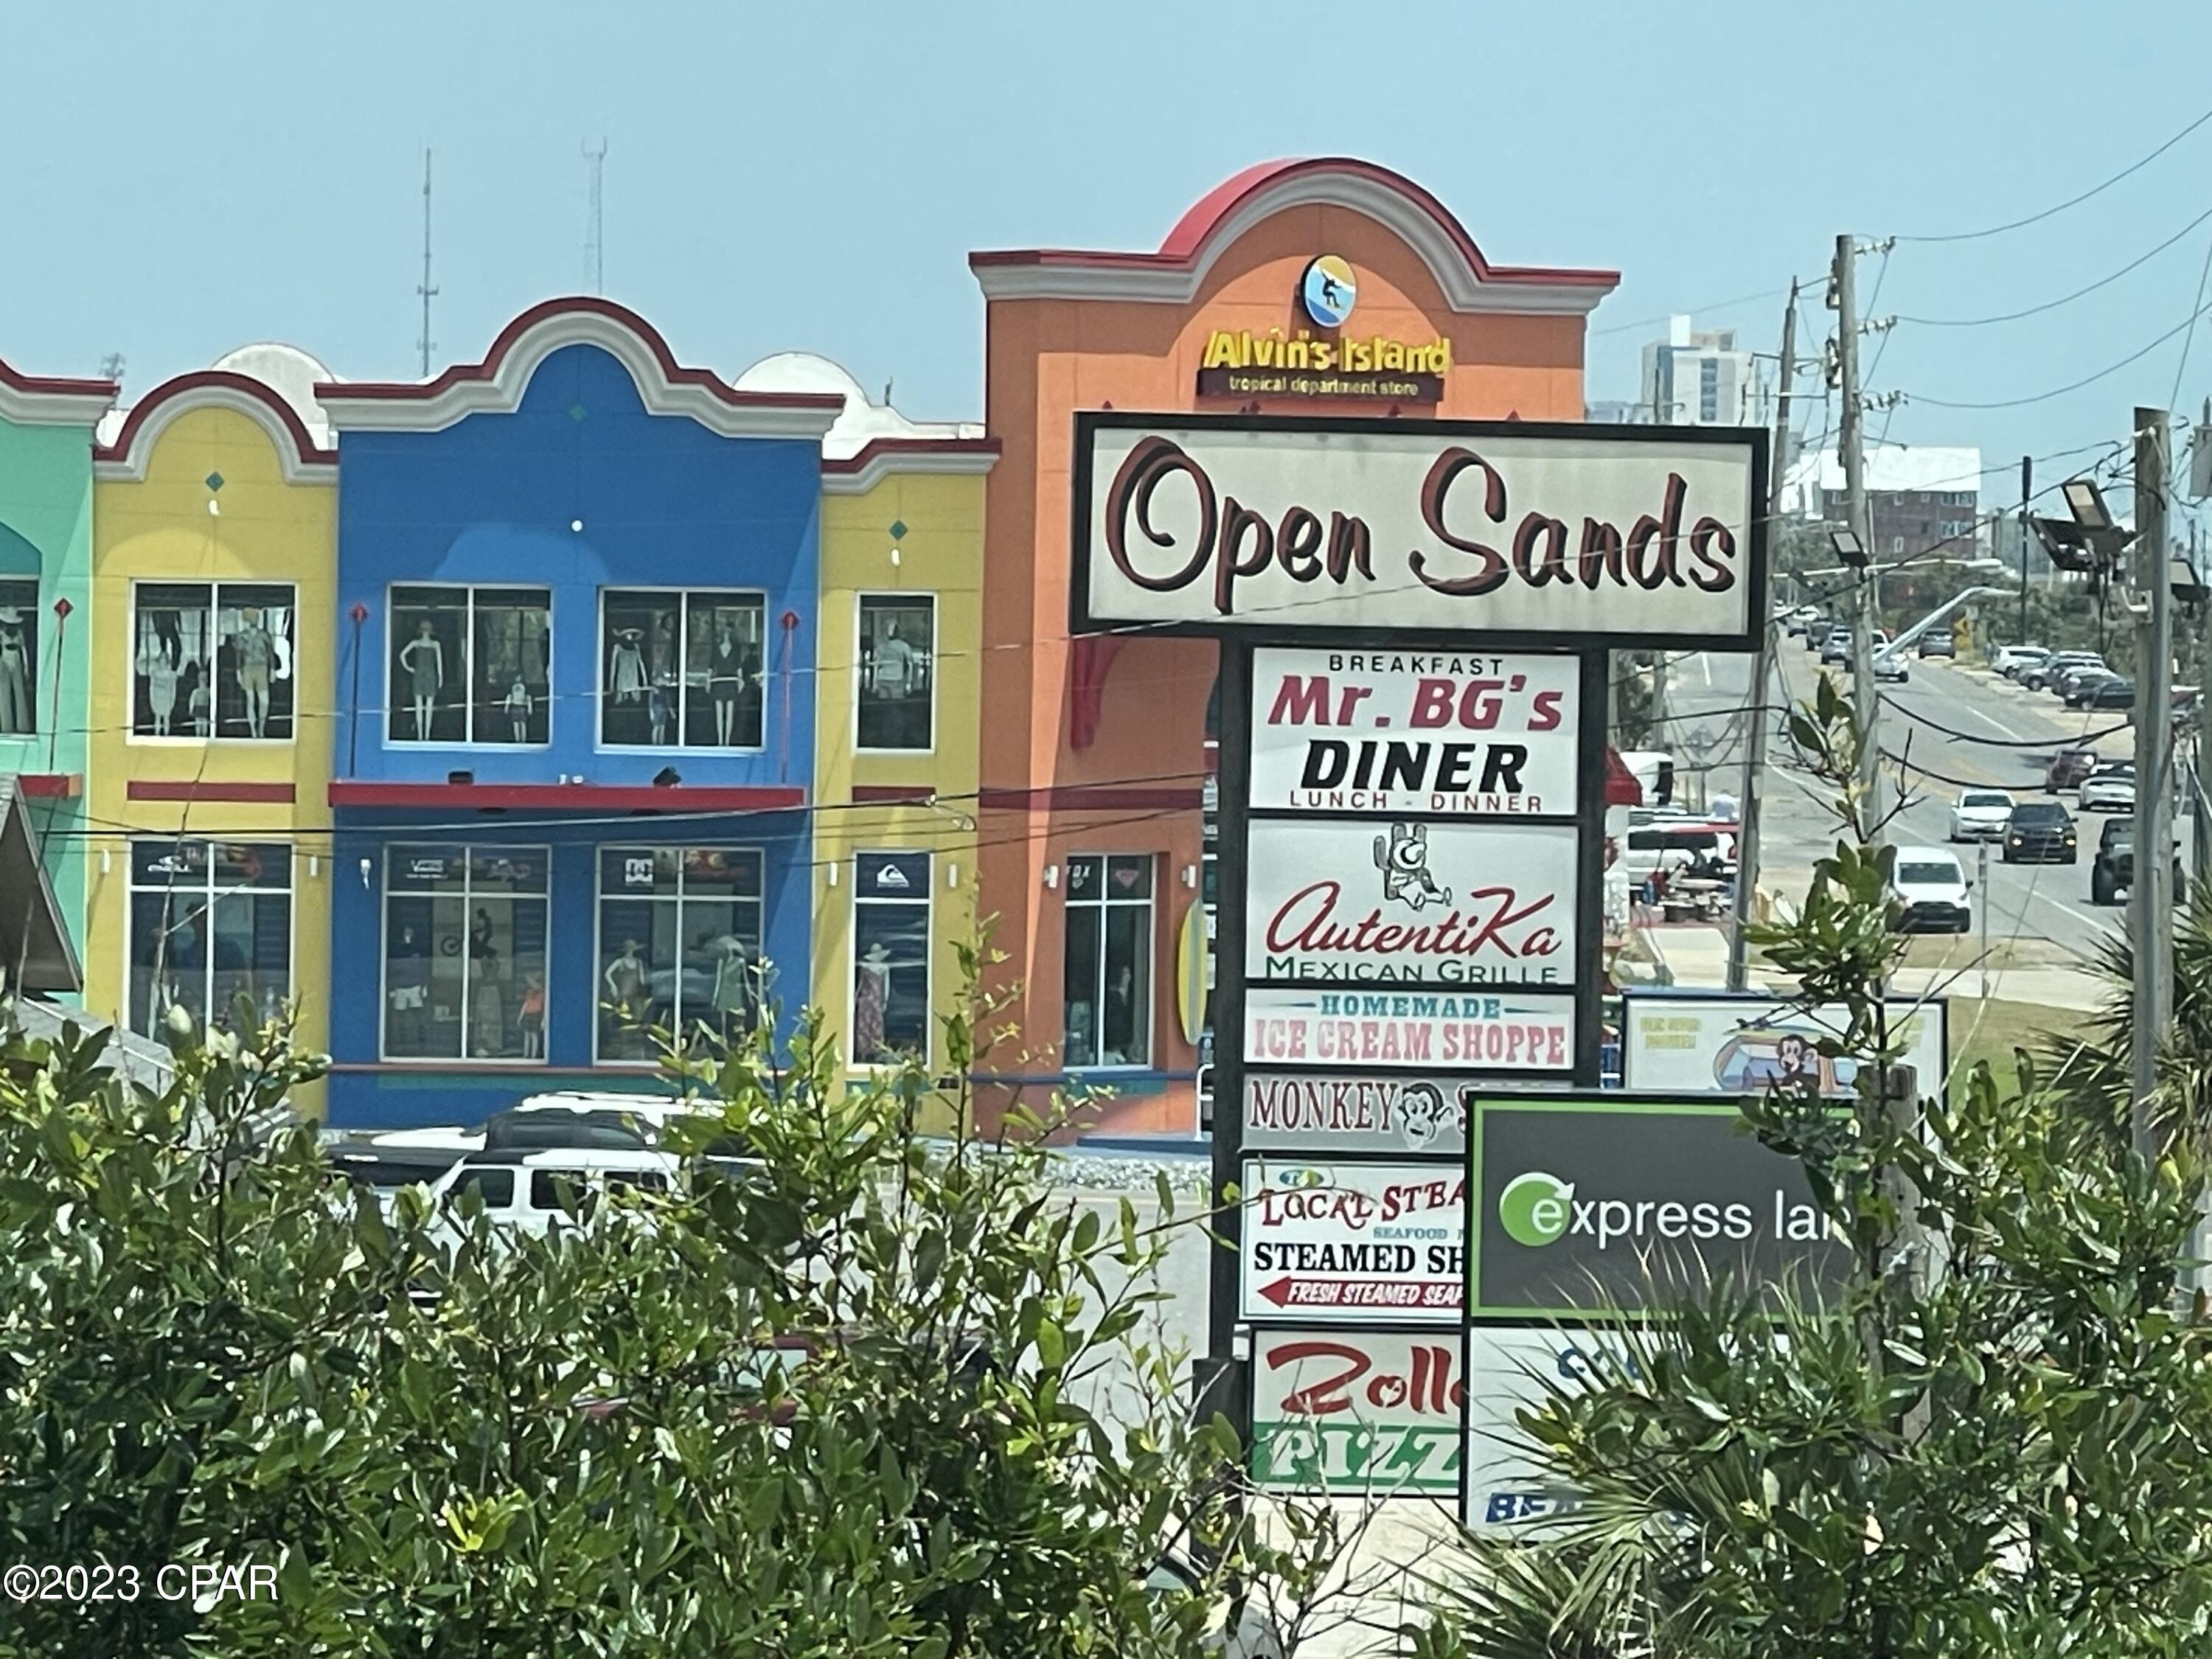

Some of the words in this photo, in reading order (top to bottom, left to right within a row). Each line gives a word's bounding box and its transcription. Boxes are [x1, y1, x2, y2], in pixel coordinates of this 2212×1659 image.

[1203, 327, 1332, 370] Alvin's
[1340, 336, 1453, 374] Island
[1229, 375, 1286, 392] tropical
[1291, 378, 1377, 396] department
[1380, 380, 1419, 396] store
[1105, 436, 1377, 616] Open
[1409, 446, 1736, 598] Sands
[1329, 655, 1504, 676] BREAKFAST
[1267, 675, 1391, 728] Mr.
[1409, 675, 1564, 731] BG's
[1301, 739, 1528, 793] DINER
[1290, 790, 1388, 810] LUNCH
[1430, 793, 1543, 813] DINNER
[1266, 880, 1563, 959] AutentiKa
[1265, 956, 1424, 982] MEXICAN
[1437, 959, 1559, 984] GRILLE
[1321, 995, 1501, 1020] HOMEMADE
[1254, 1019, 1307, 1059] ICE
[1317, 1020, 1433, 1062] CREAM
[1443, 1024, 1566, 1065] SHOPPE
[1249, 1079, 1399, 1132] MONKEY
[1262, 1189, 1374, 1231] LOCAL
[1531, 1195, 1753, 1251] express
[1373, 1227, 1448, 1240] SEAFOOD
[1254, 1242, 1416, 1273] STEAMED
[1427, 1245, 1464, 1274] SH
[1287, 1281, 1342, 1304] FRESH
[1342, 1283, 1421, 1304] STEAMED
